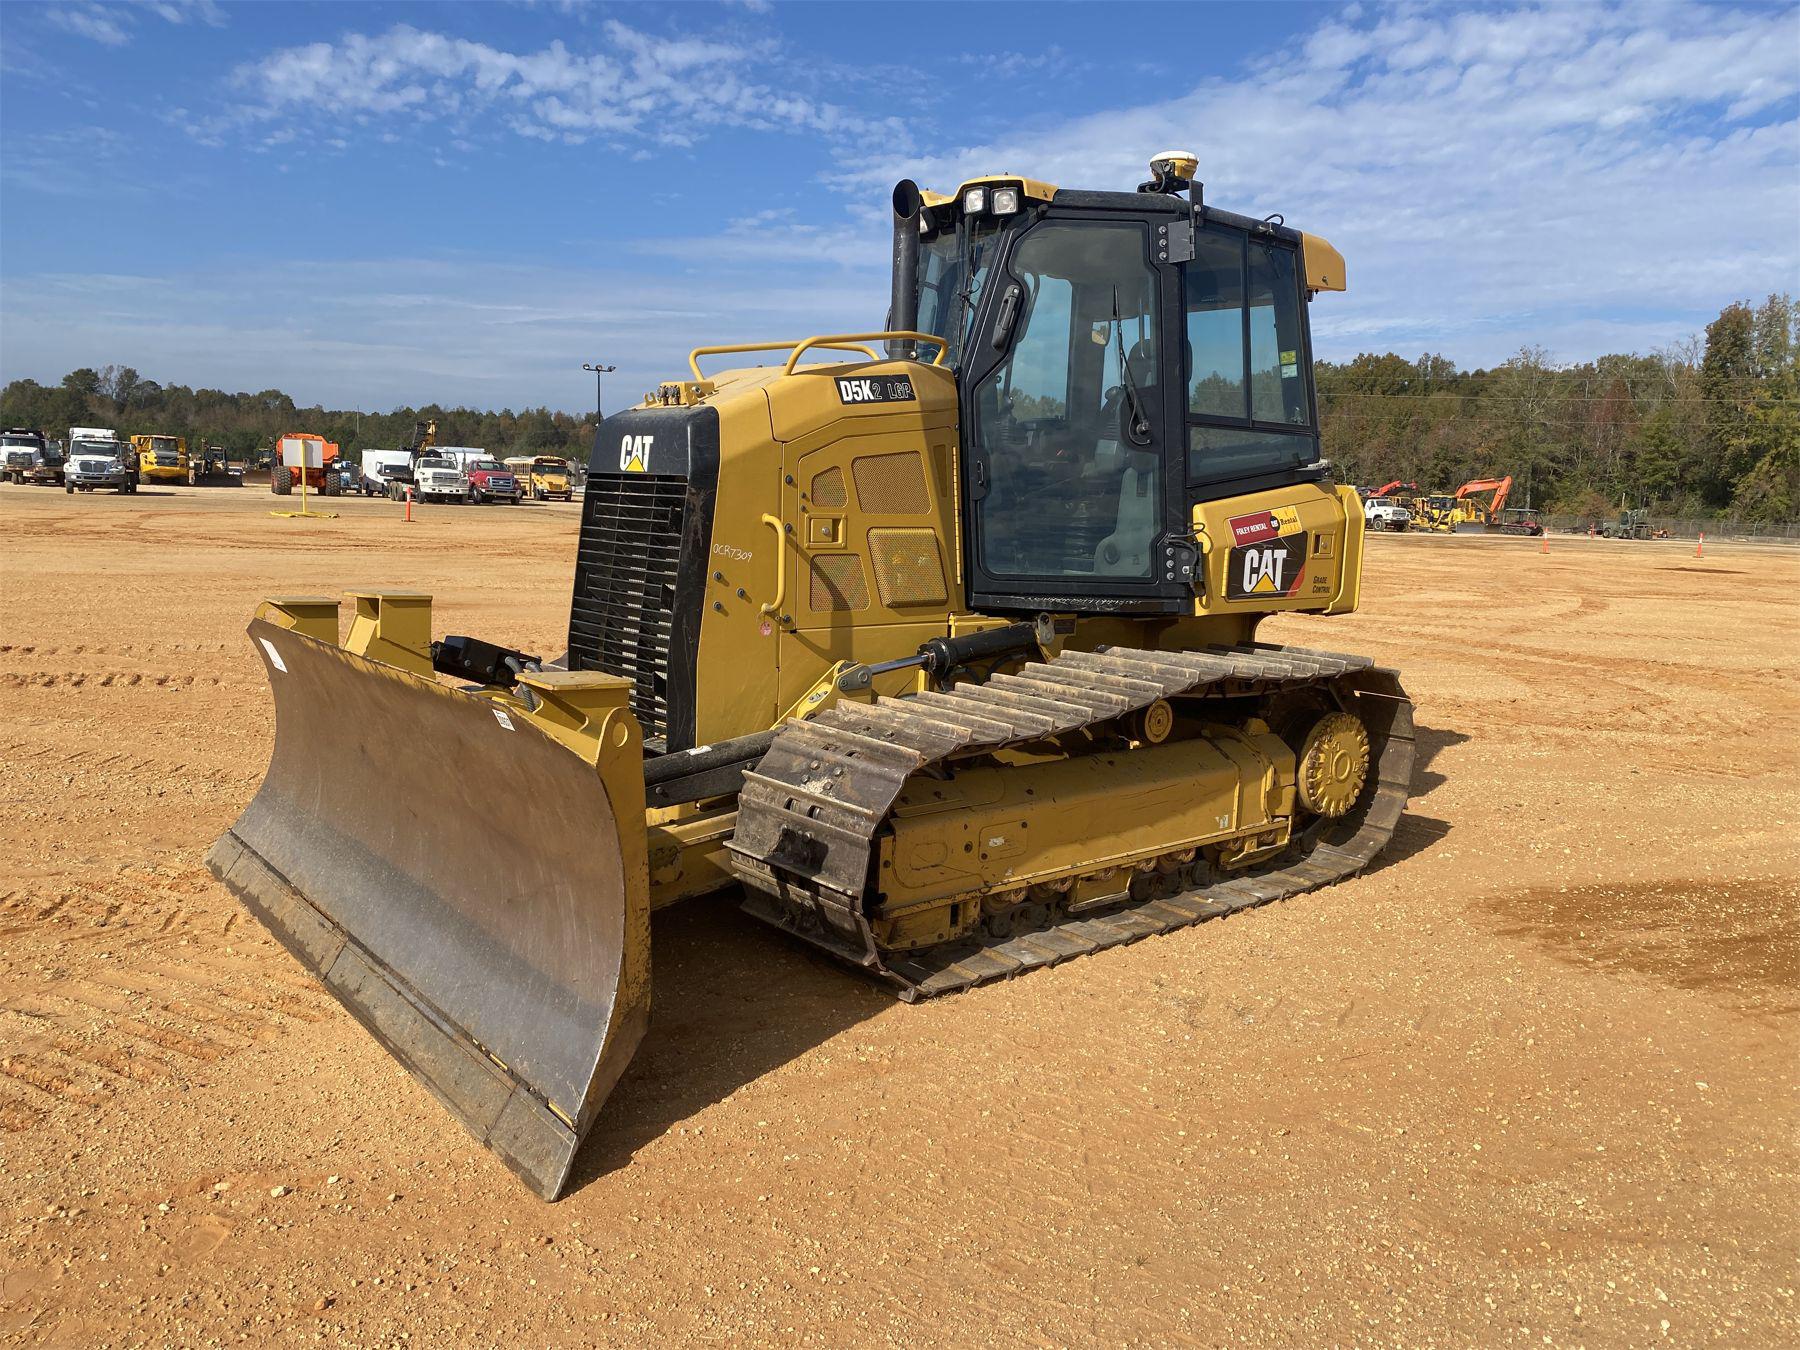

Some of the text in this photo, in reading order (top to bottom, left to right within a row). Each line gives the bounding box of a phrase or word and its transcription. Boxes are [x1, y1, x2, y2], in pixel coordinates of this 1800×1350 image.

[887, 383, 911, 399] LGP
[619, 435, 654, 472] CAT
[1280, 516, 1297, 525] Rental
[1236, 526, 1251, 535] FOLEY
[1250, 523, 1267, 533] RENTAL
[1243, 549, 1287, 592] CAT
